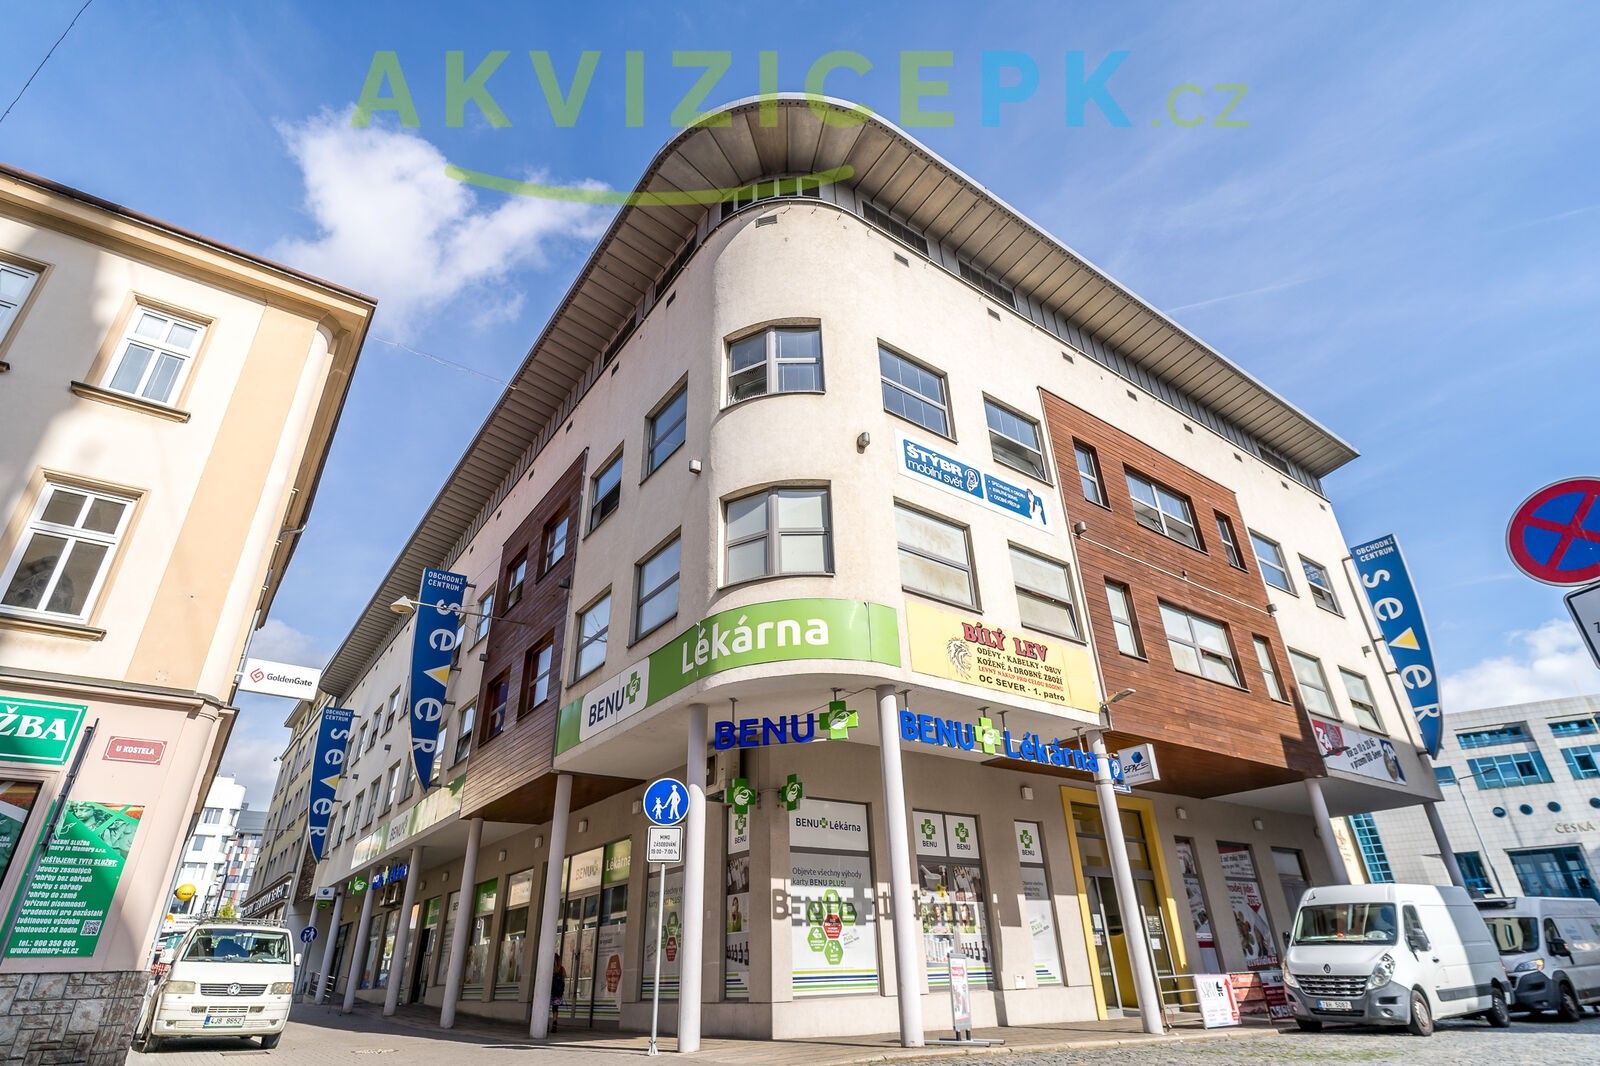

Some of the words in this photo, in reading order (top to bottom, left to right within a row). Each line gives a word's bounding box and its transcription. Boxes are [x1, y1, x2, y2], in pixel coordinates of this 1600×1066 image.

[906, 442, 962, 476] ŠTÝBR
[908, 460, 942, 480] mobilní
[944, 472, 964, 489] svět
[1360, 546, 1394, 562] CENTRUM
[427, 579, 460, 591] CENTRUM
[428, 571, 463, 585] OBCHODNÍ
[681, 614, 829, 674] Lékárna
[962, 621, 1006, 651] BÍLÝ
[1013, 637, 1048, 661] LEV
[977, 647, 1001, 659] ODĚVY
[1007, 655, 1039, 669] KABELKY
[1044, 664, 1062, 675] OBUV
[977, 656, 1006, 671] KOŽENÉ
[1014, 667, 1042, 681] DROBNÉ
[1044, 673, 1063, 685] ZBOŽÍ
[266, 673, 312, 686] GoldenGate
[979, 674, 993, 684] OC
[996, 678, 1026, 692] SEVER
[1034, 688, 1041, 696] 1.
[1043, 691, 1065, 701] patro
[588, 686, 625, 727] BENU
[714, 713, 815, 750] BENU
[899, 710, 975, 751] BENU
[1003, 731, 1100, 773] Lékárna
[123, 746, 155, 755] KOSTELA
[795, 817, 819, 828] BENU
[829, 820, 861, 832] Lékárna
[734, 835, 747, 845] BENU
[922, 840, 938, 848] BENU
[956, 843, 971, 851] BENU
[1022, 849, 1036, 857] BENU
[792, 867, 818, 879] Objevte
[818, 867, 841, 878] všechny
[841, 868, 862, 879] výhody
[792, 878, 809, 887] karty
[809, 879, 828, 887] BENU
